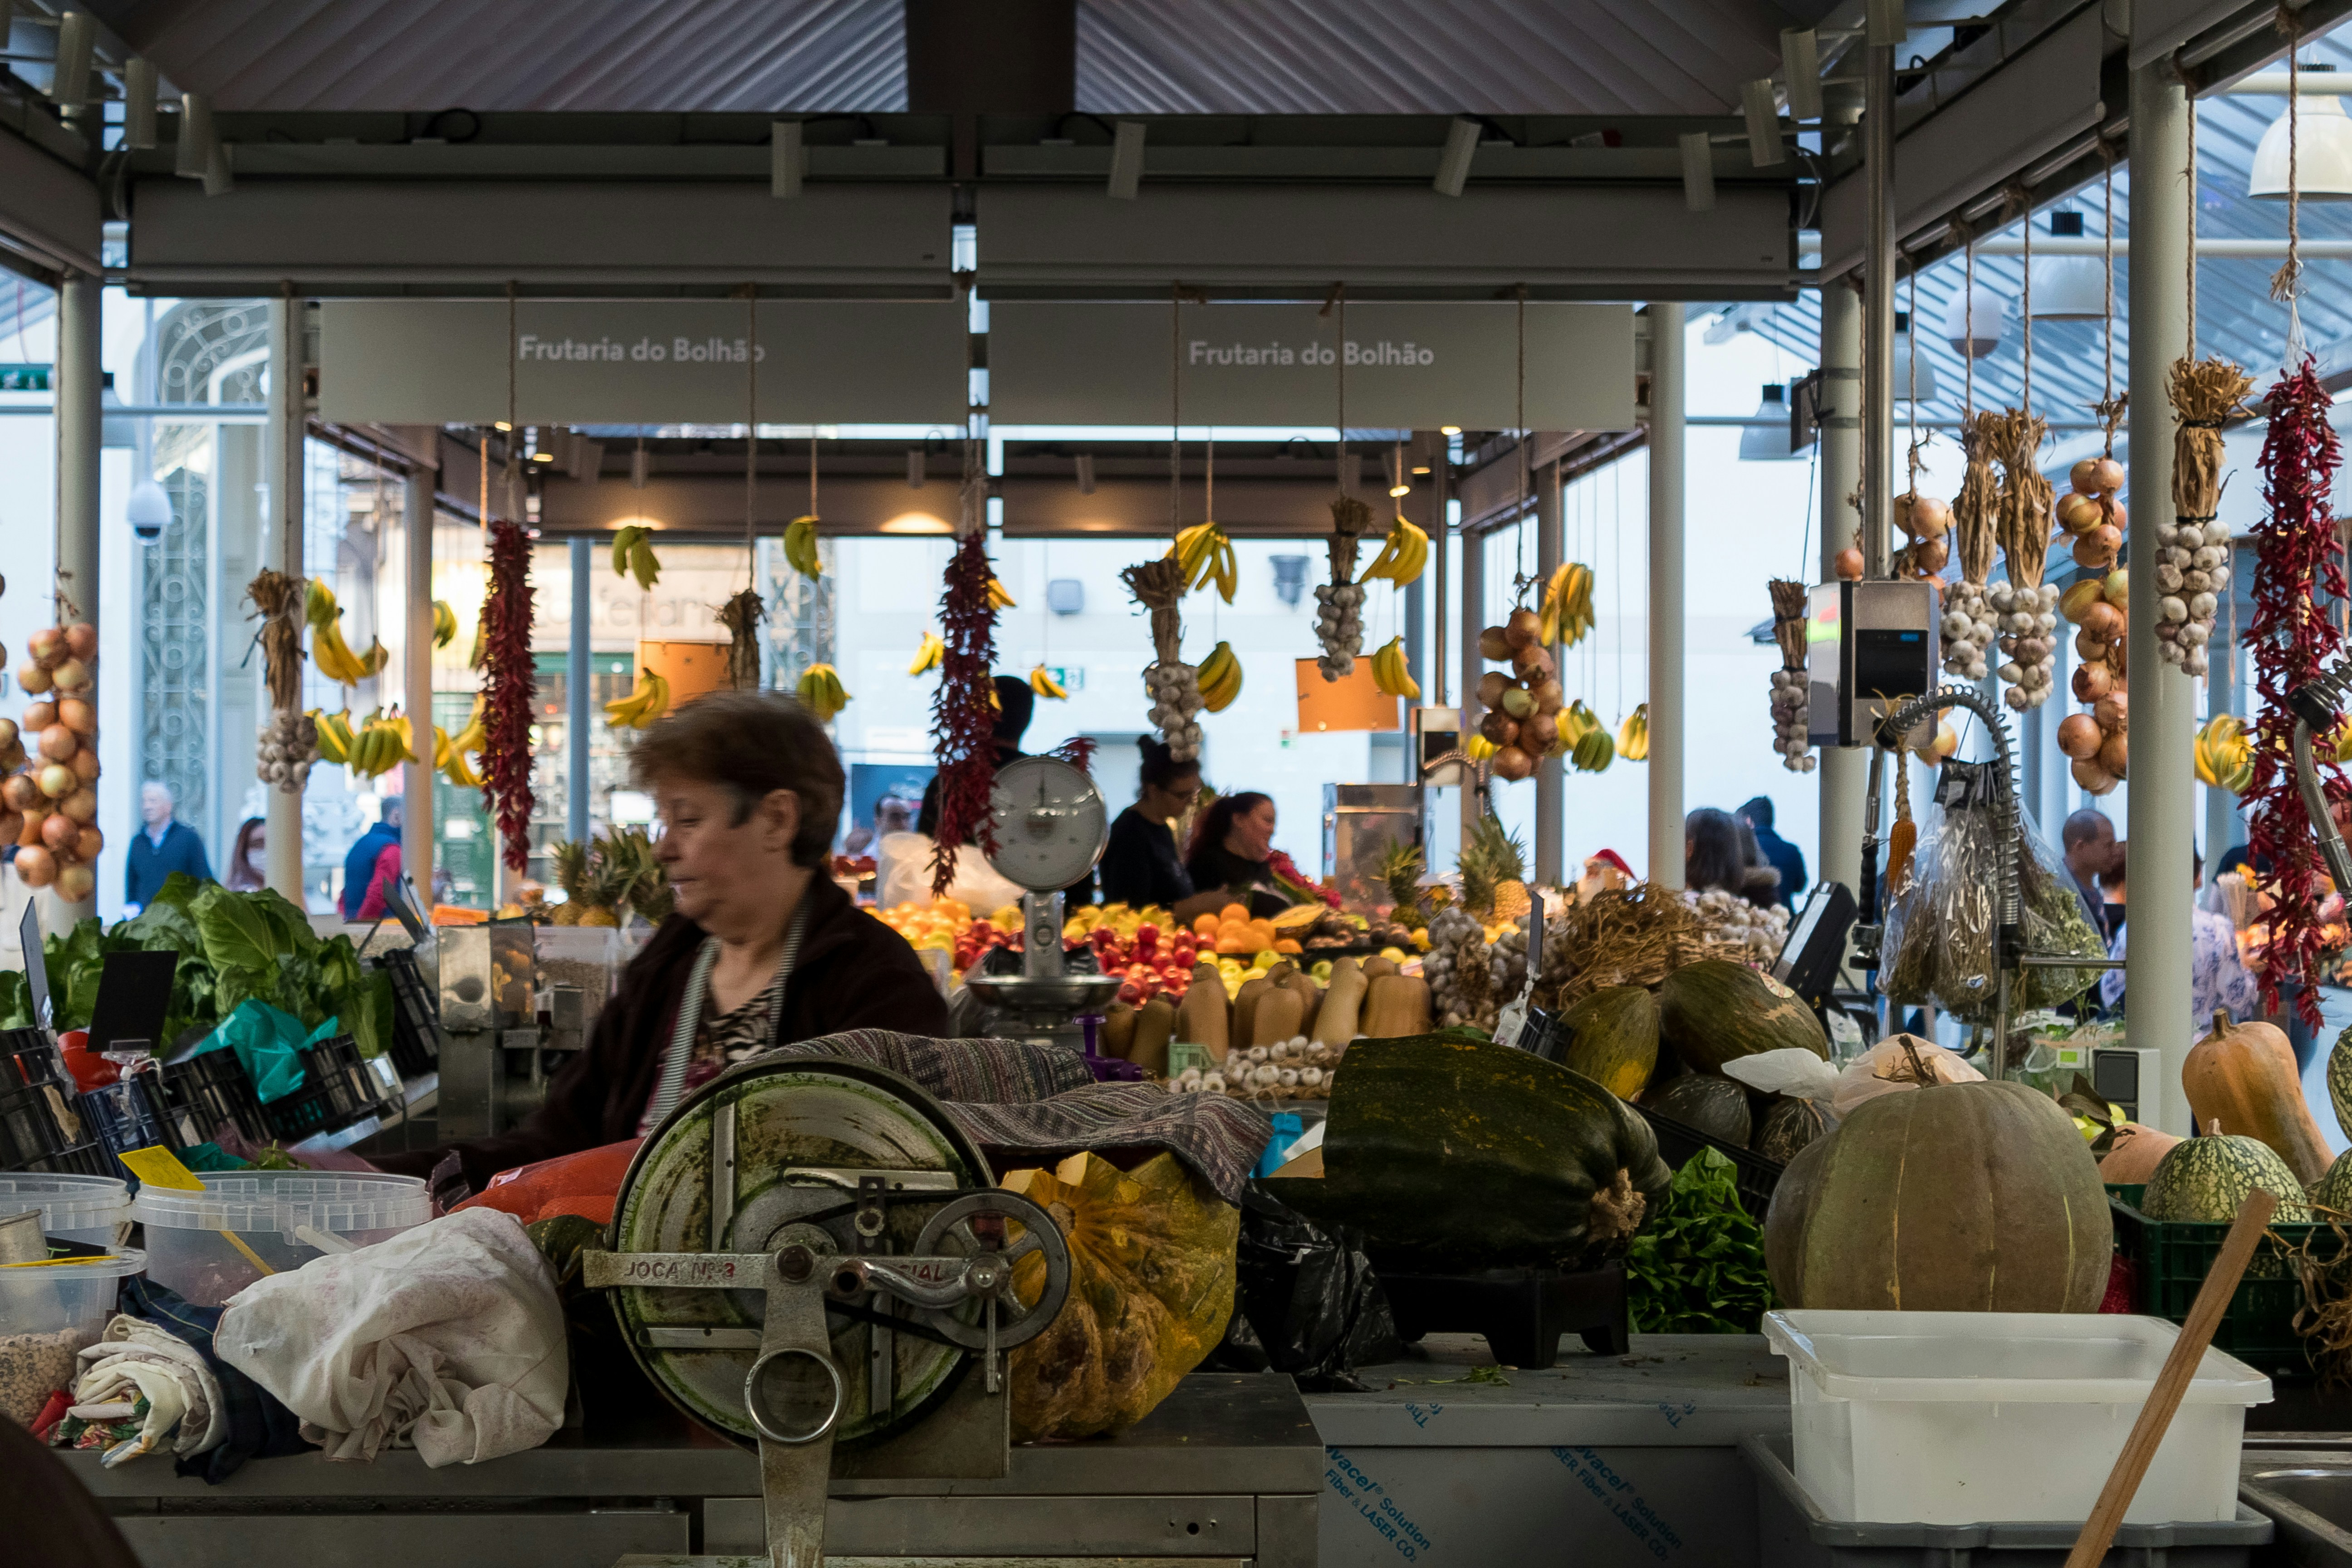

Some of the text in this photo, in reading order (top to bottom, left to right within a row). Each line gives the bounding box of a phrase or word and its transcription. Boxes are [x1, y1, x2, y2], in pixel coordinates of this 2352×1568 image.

[518, 335, 765, 362] Frutaria do Bolhão
[1189, 341, 1434, 365] Frutaria do Bolhão
[624, 1261, 678, 1279] JOCA
[1325, 1469, 1354, 1499] Fiber
[1352, 1498, 1361, 1508] &
[1360, 1504, 1397, 1542] LASER
[1380, 1497, 1431, 1551] Solution
[1577, 1469, 1607, 1498] Fiber
[1612, 1504, 1649, 1542] LASER
[1632, 1497, 1682, 1549] Solution
